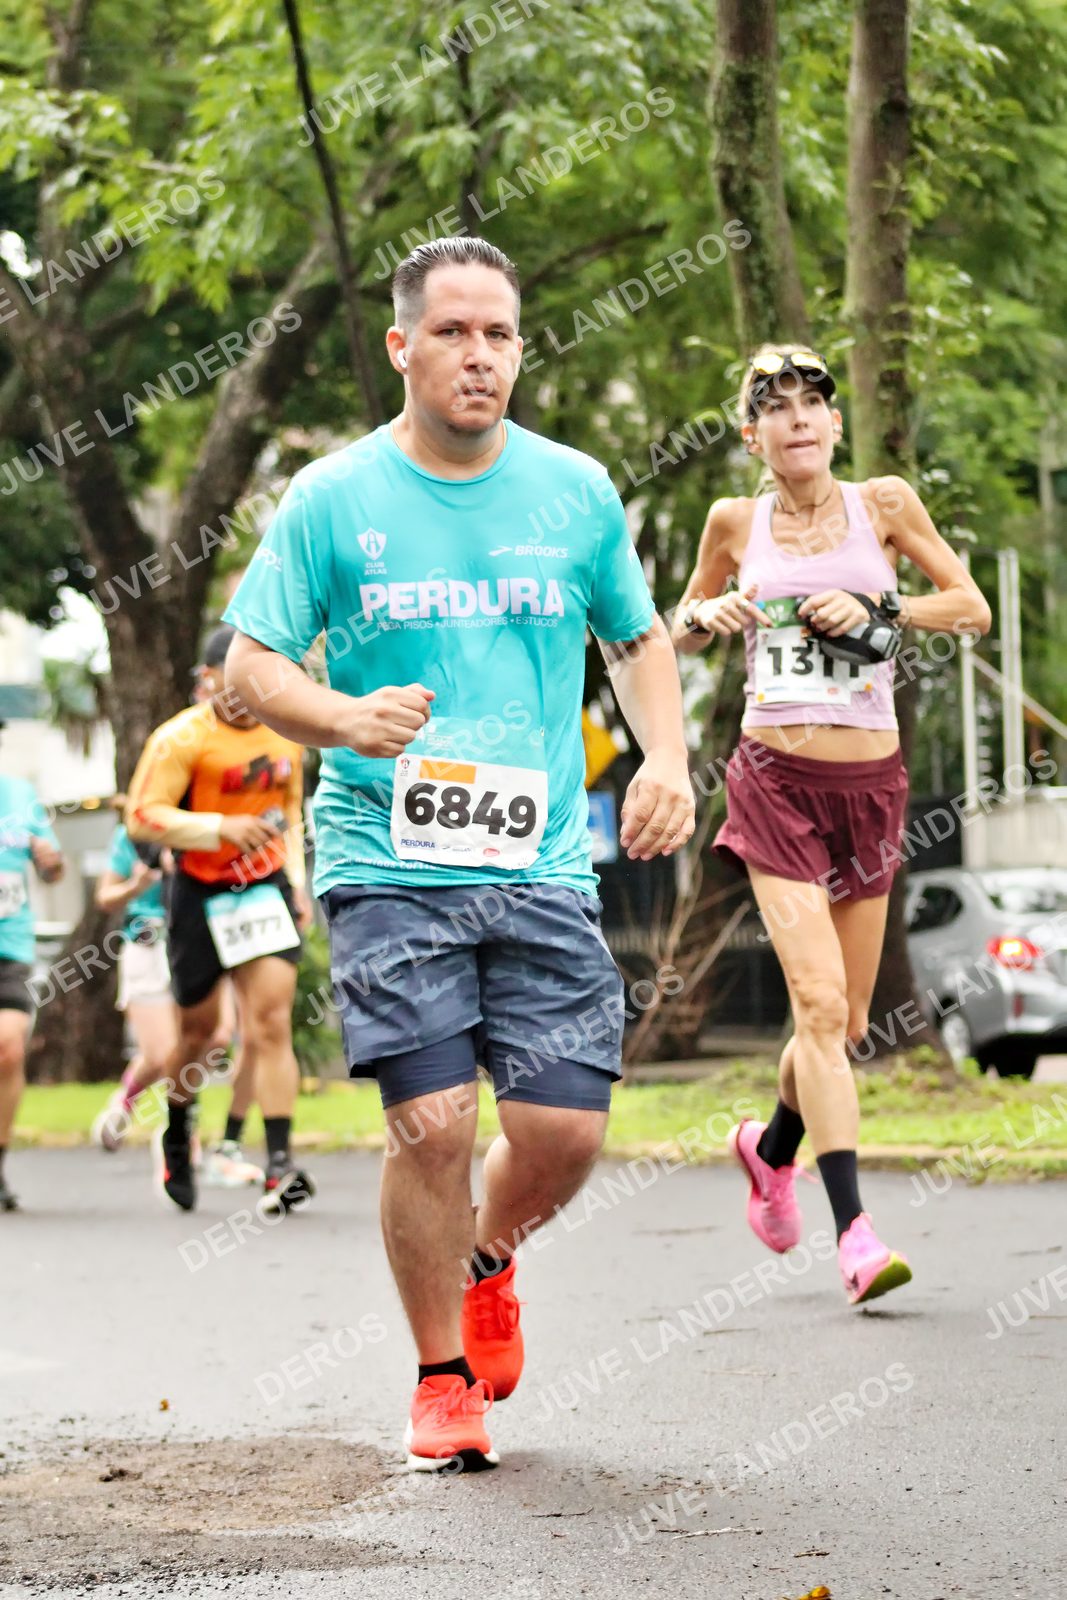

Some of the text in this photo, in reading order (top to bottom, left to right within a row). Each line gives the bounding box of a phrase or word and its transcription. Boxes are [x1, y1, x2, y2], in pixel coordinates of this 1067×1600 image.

[514, 545, 569, 558] BROOKS
[364, 568, 387, 576] ATLAS
[359, 577, 565, 621] PERDURA
[403, 620, 433, 630] PISOS
[440, 616, 508, 629] JUNTEADORES
[516, 616, 559, 627] ESTUCOS
[405, 782, 536, 838] 6849
[400, 838, 436, 848] PERDURA
